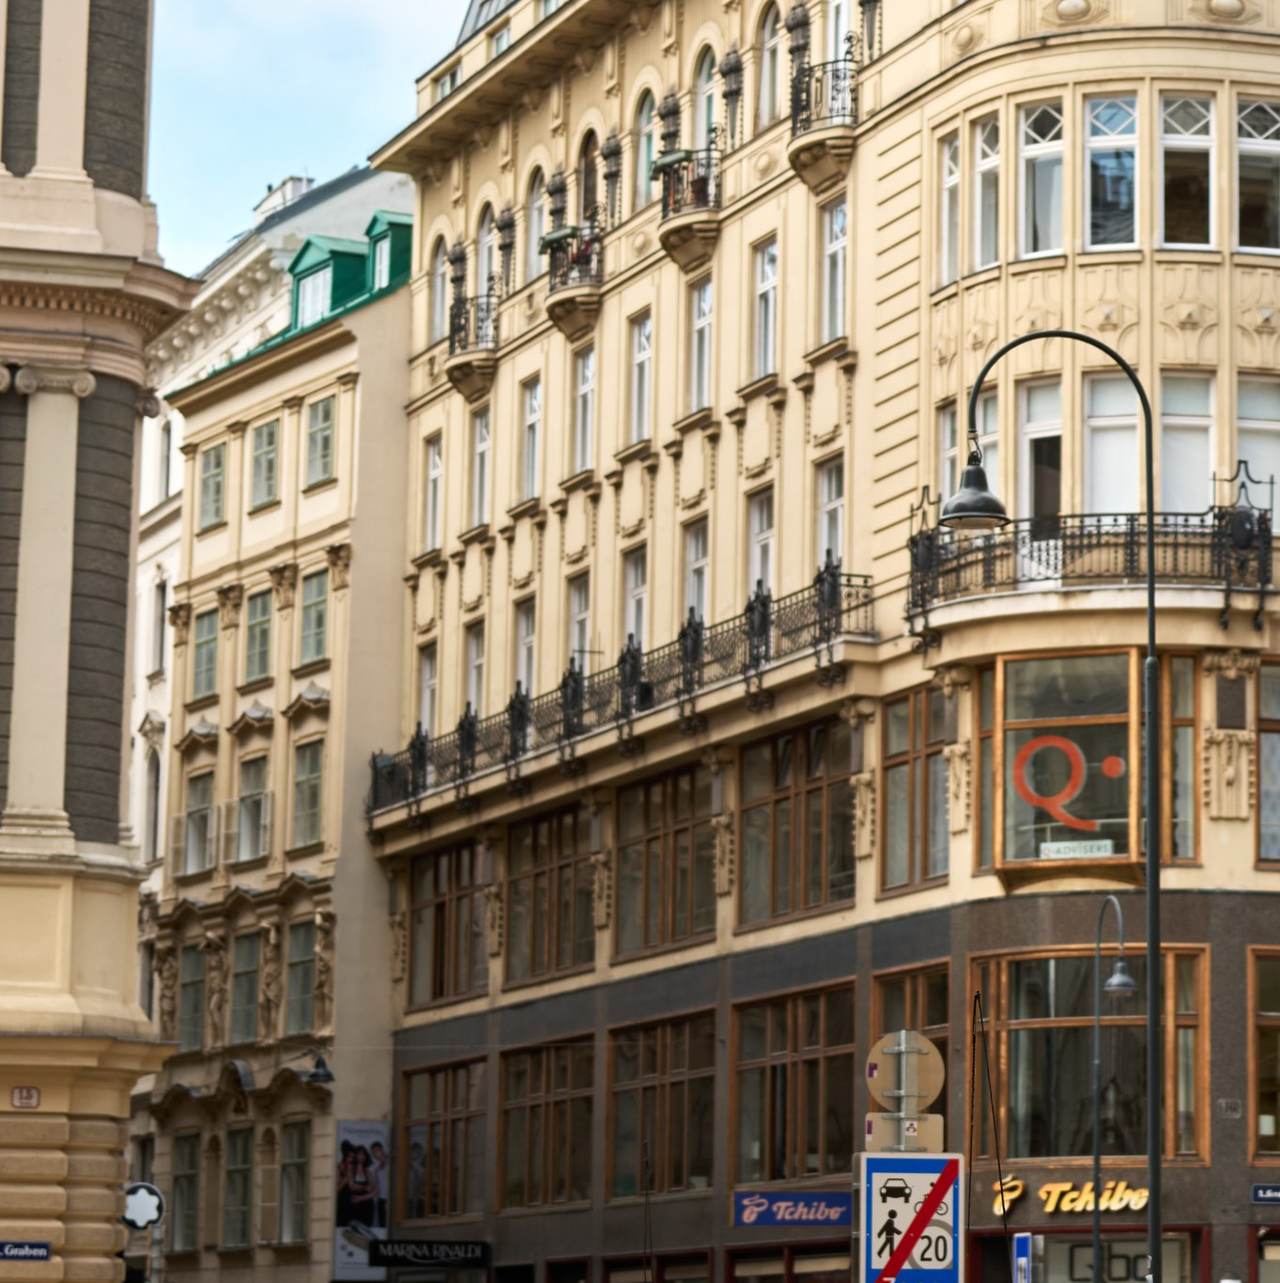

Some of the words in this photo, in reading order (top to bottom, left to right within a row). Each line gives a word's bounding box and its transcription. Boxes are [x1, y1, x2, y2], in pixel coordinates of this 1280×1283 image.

[1038, 1181, 1150, 1212] Tchibo
[772, 1201, 847, 1220] Tchibo
[4, 1243, 47, 1256] Graben
[380, 1243, 430, 1259] MARINA
[433, 1243, 482, 1259] RINALDI
[920, 1234, 948, 1262] 20
